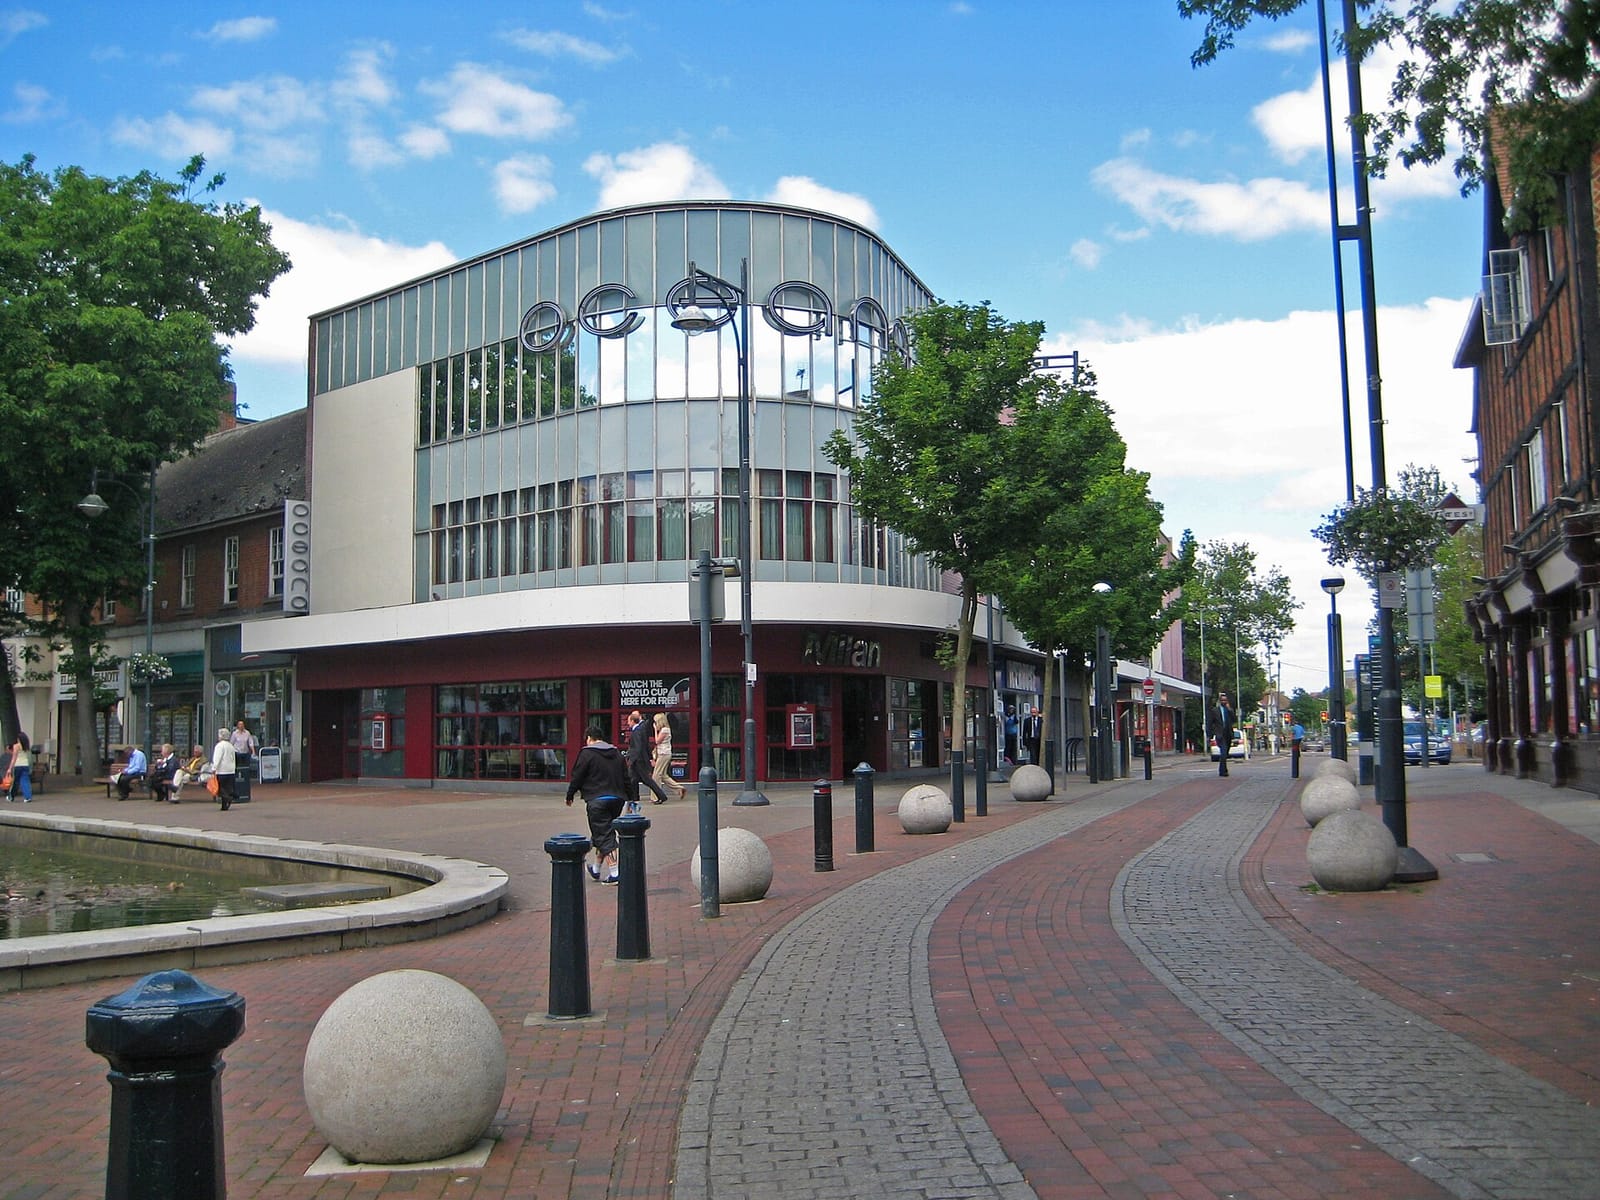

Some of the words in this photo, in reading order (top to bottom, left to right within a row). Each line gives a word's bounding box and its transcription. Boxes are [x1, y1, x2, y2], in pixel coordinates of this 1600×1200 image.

[290, 503, 310, 610] oceana
[620, 679, 648, 688] WATCH
[649, 679, 663, 688] THE
[620, 688, 651, 697] WORLD
[651, 688, 668, 697] CUP
[620, 697, 639, 706] HERE
[640, 696, 657, 705] FOR
